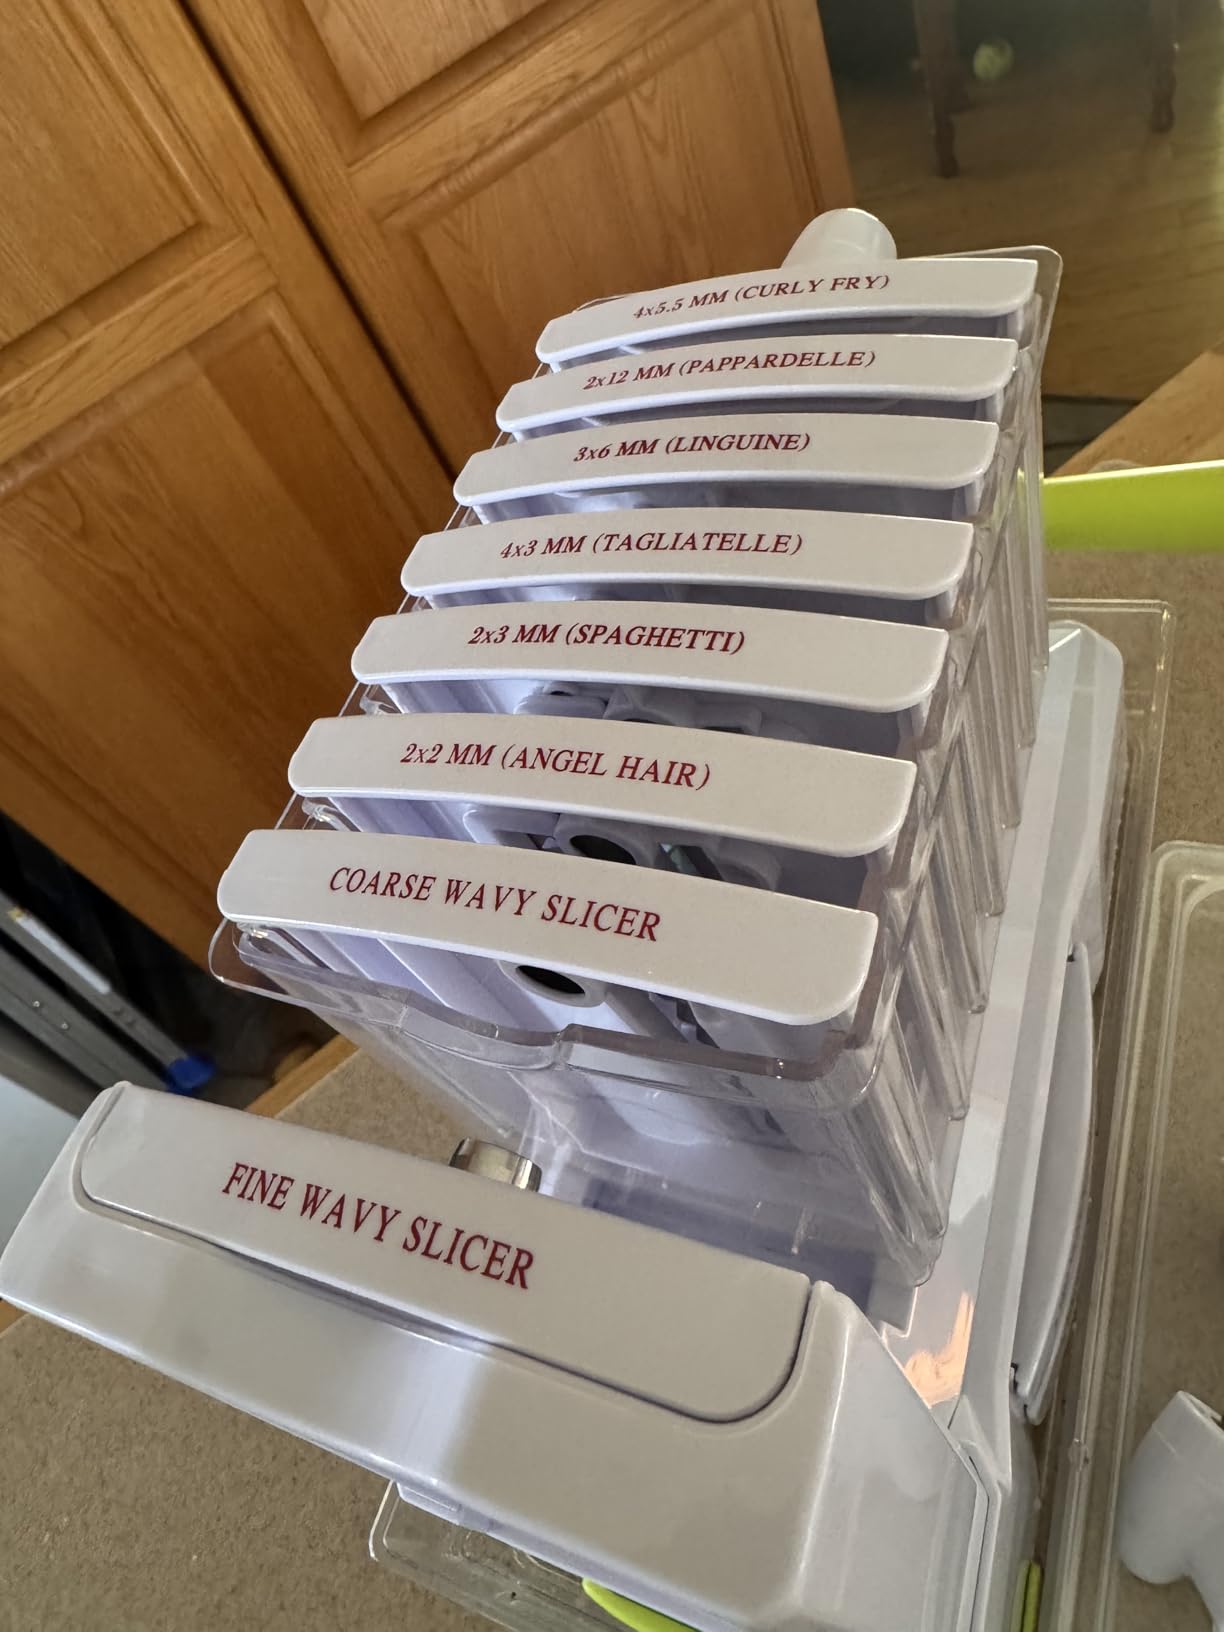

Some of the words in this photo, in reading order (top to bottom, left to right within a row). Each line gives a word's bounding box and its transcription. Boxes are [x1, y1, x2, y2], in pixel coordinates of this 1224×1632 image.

[633, 296, 685, 319] 4x5.5
[687, 289, 731, 308] MM
[734, 278, 824, 302] (CURLY
[830, 275, 890, 292] FRY)
[583, 369, 629, 390] 2x12
[633, 362, 676, 381] MM
[678, 350, 877, 376] (PAPPARDELLE)
[573, 443, 613, 462] 3x6
[615, 437, 660, 457] MM
[664, 433, 811, 455] (LINGUINE)
[500, 538, 538, 559] 4x3
[541, 535, 588, 555] MM
[591, 532, 802, 555] (TAGLIATELLE)
[467, 625, 511, 645] 2x3
[512, 623, 563, 644] MM
[564, 621, 746, 655] (SPAGHETTI)
[399, 743, 444, 765] 2x2
[444, 743, 497, 766] MM
[500, 744, 609, 776] (ANGEL
[616, 755, 712, 791] HAIR)
[329, 867, 436, 902] COARSE
[443, 877, 537, 916] WAVY
[541, 895, 662, 942] SLICER
[222, 1162, 295, 1211] FINE
[297, 1181, 400, 1244] WAVY
[402, 1215, 536, 1290] SLICER
